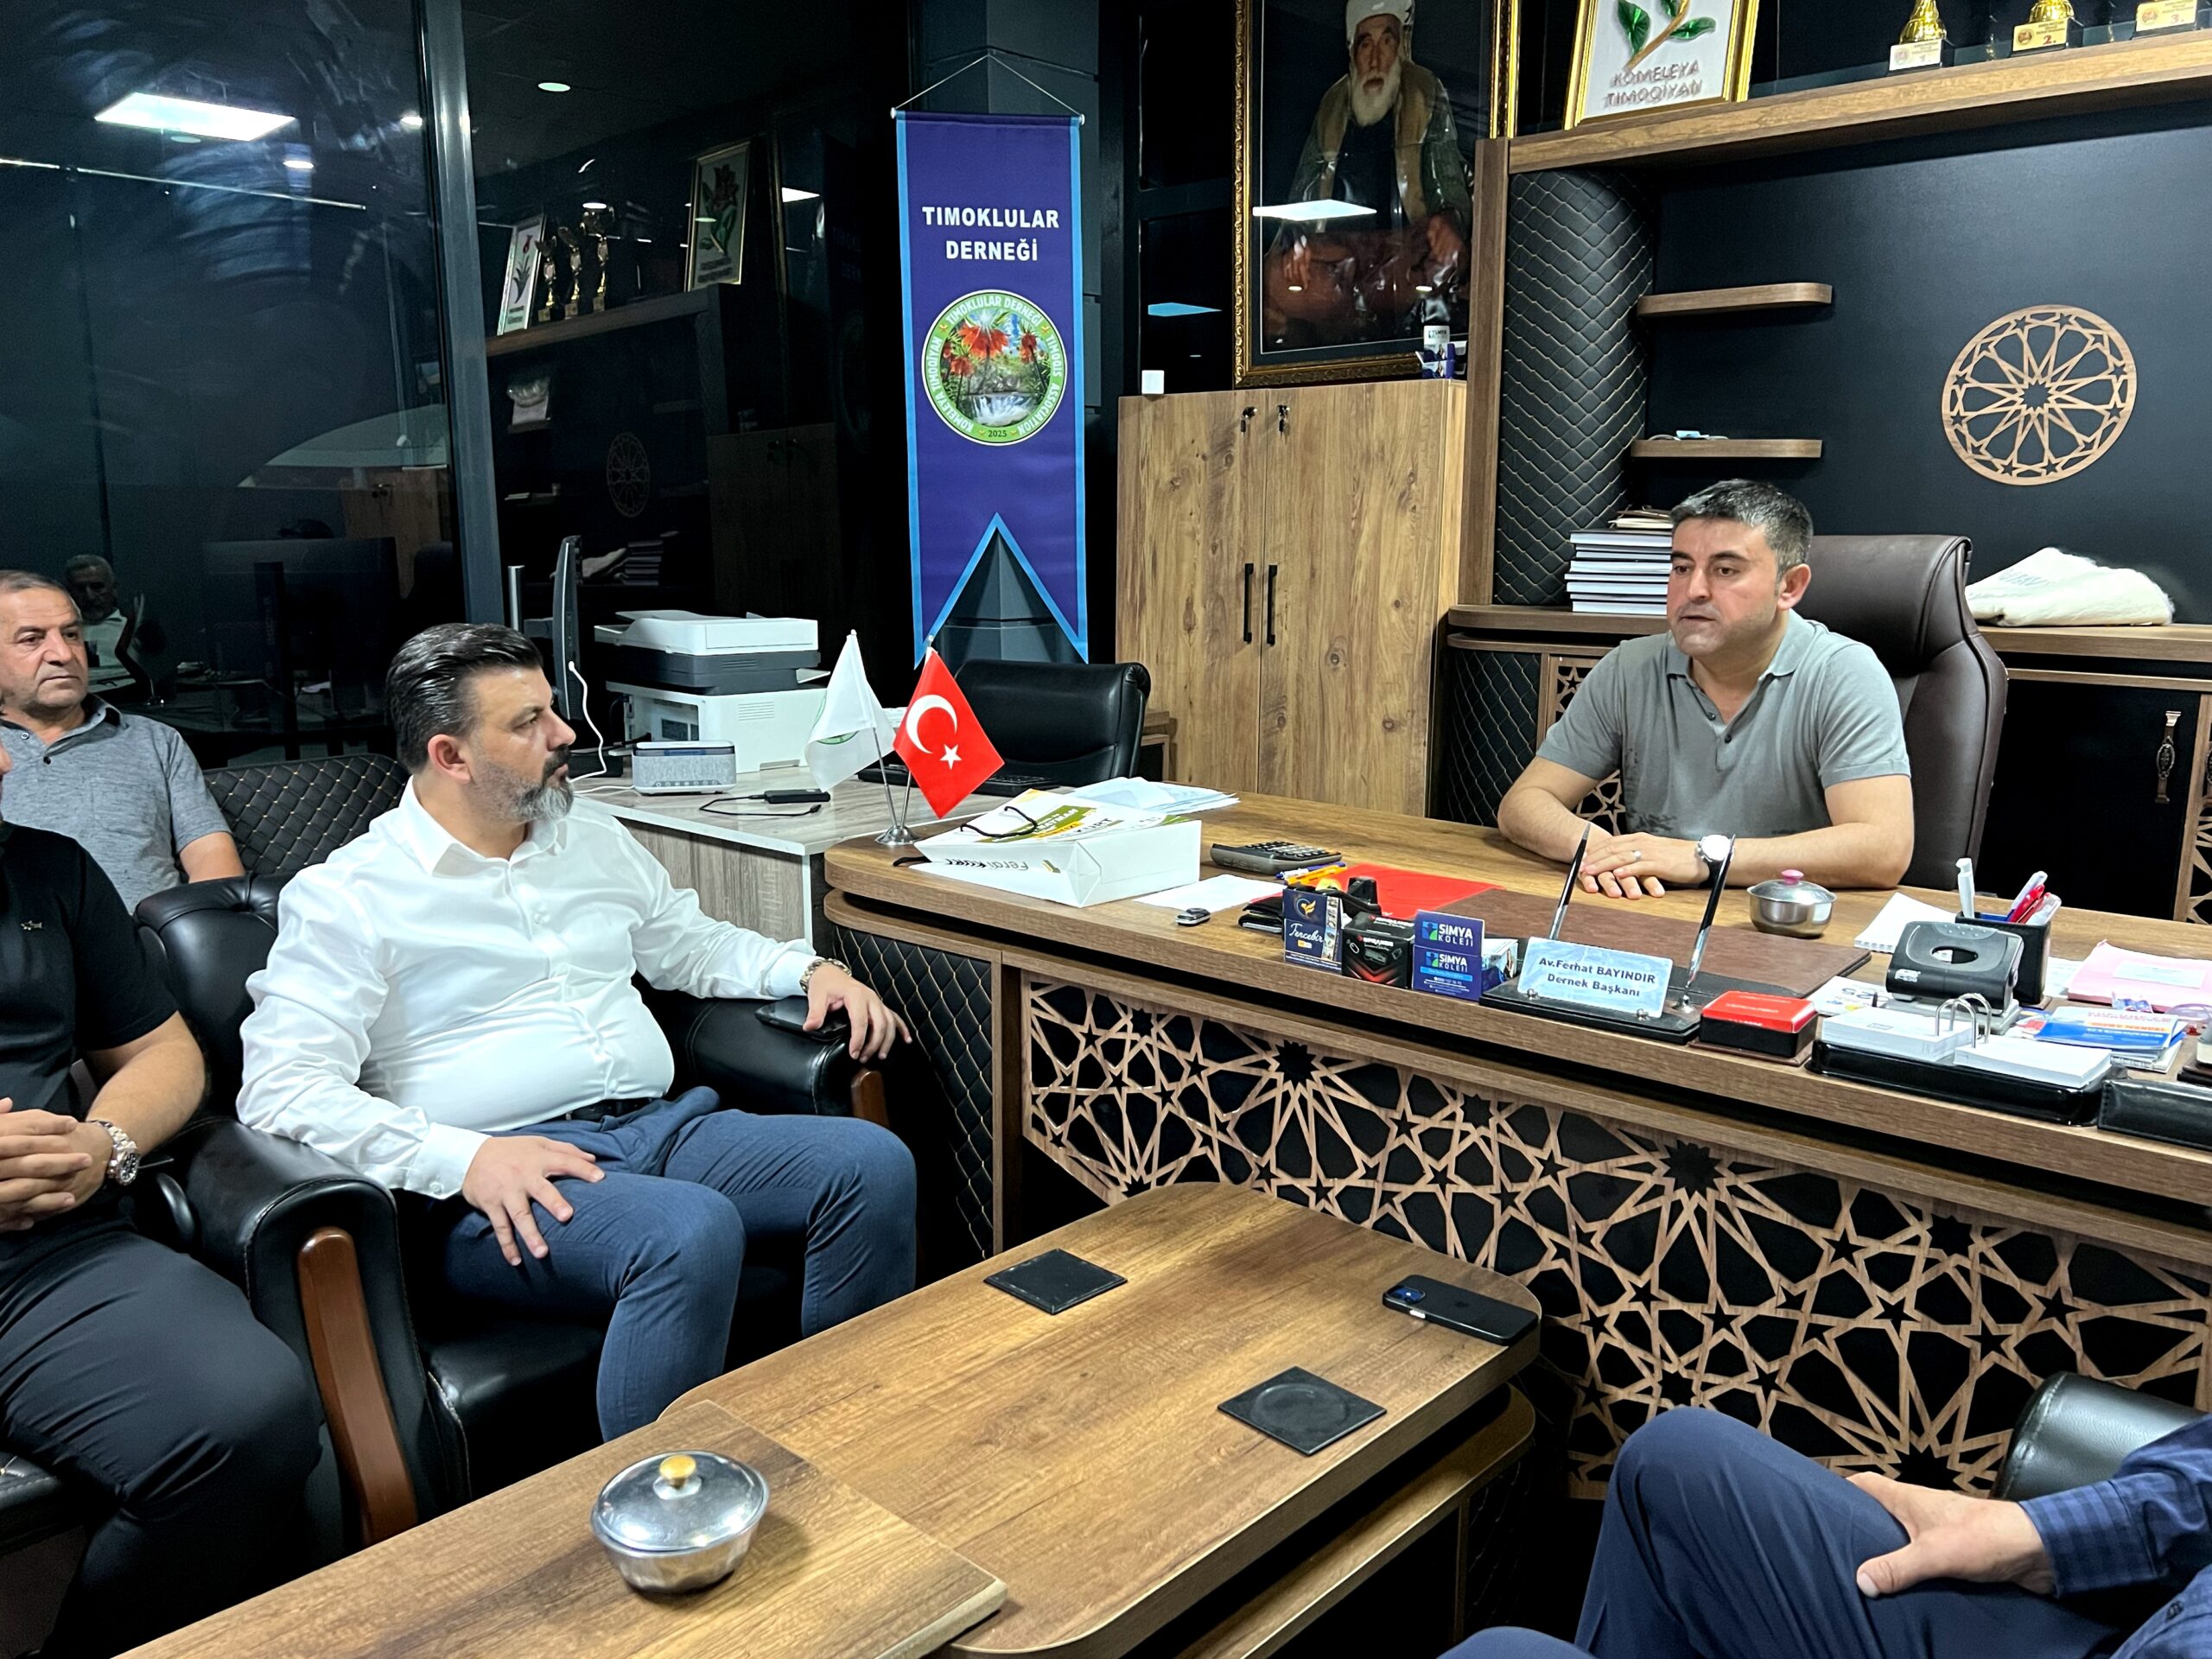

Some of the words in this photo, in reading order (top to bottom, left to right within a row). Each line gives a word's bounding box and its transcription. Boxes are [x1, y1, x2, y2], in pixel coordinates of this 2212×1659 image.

[2043, 35, 2056, 45] 2.
[1611, 60, 1700, 86] KOMELEYA
[922, 207, 1059, 228] TIMOKLULAR
[946, 238, 1038, 261] DERNEĞİ
[945, 296, 1001, 324] TIMOKLULAR
[935, 393, 974, 432] KOMELEYA
[1018, 384, 1059, 435] ASSOCIATION
[988, 429, 1007, 438] 2025
[1539, 957, 1593, 974] Av.Ferhat
[1597, 966, 1656, 983] BAYINDIR
[1548, 973, 1588, 988] Dernek
[1592, 981, 1640, 996] Başkanı
